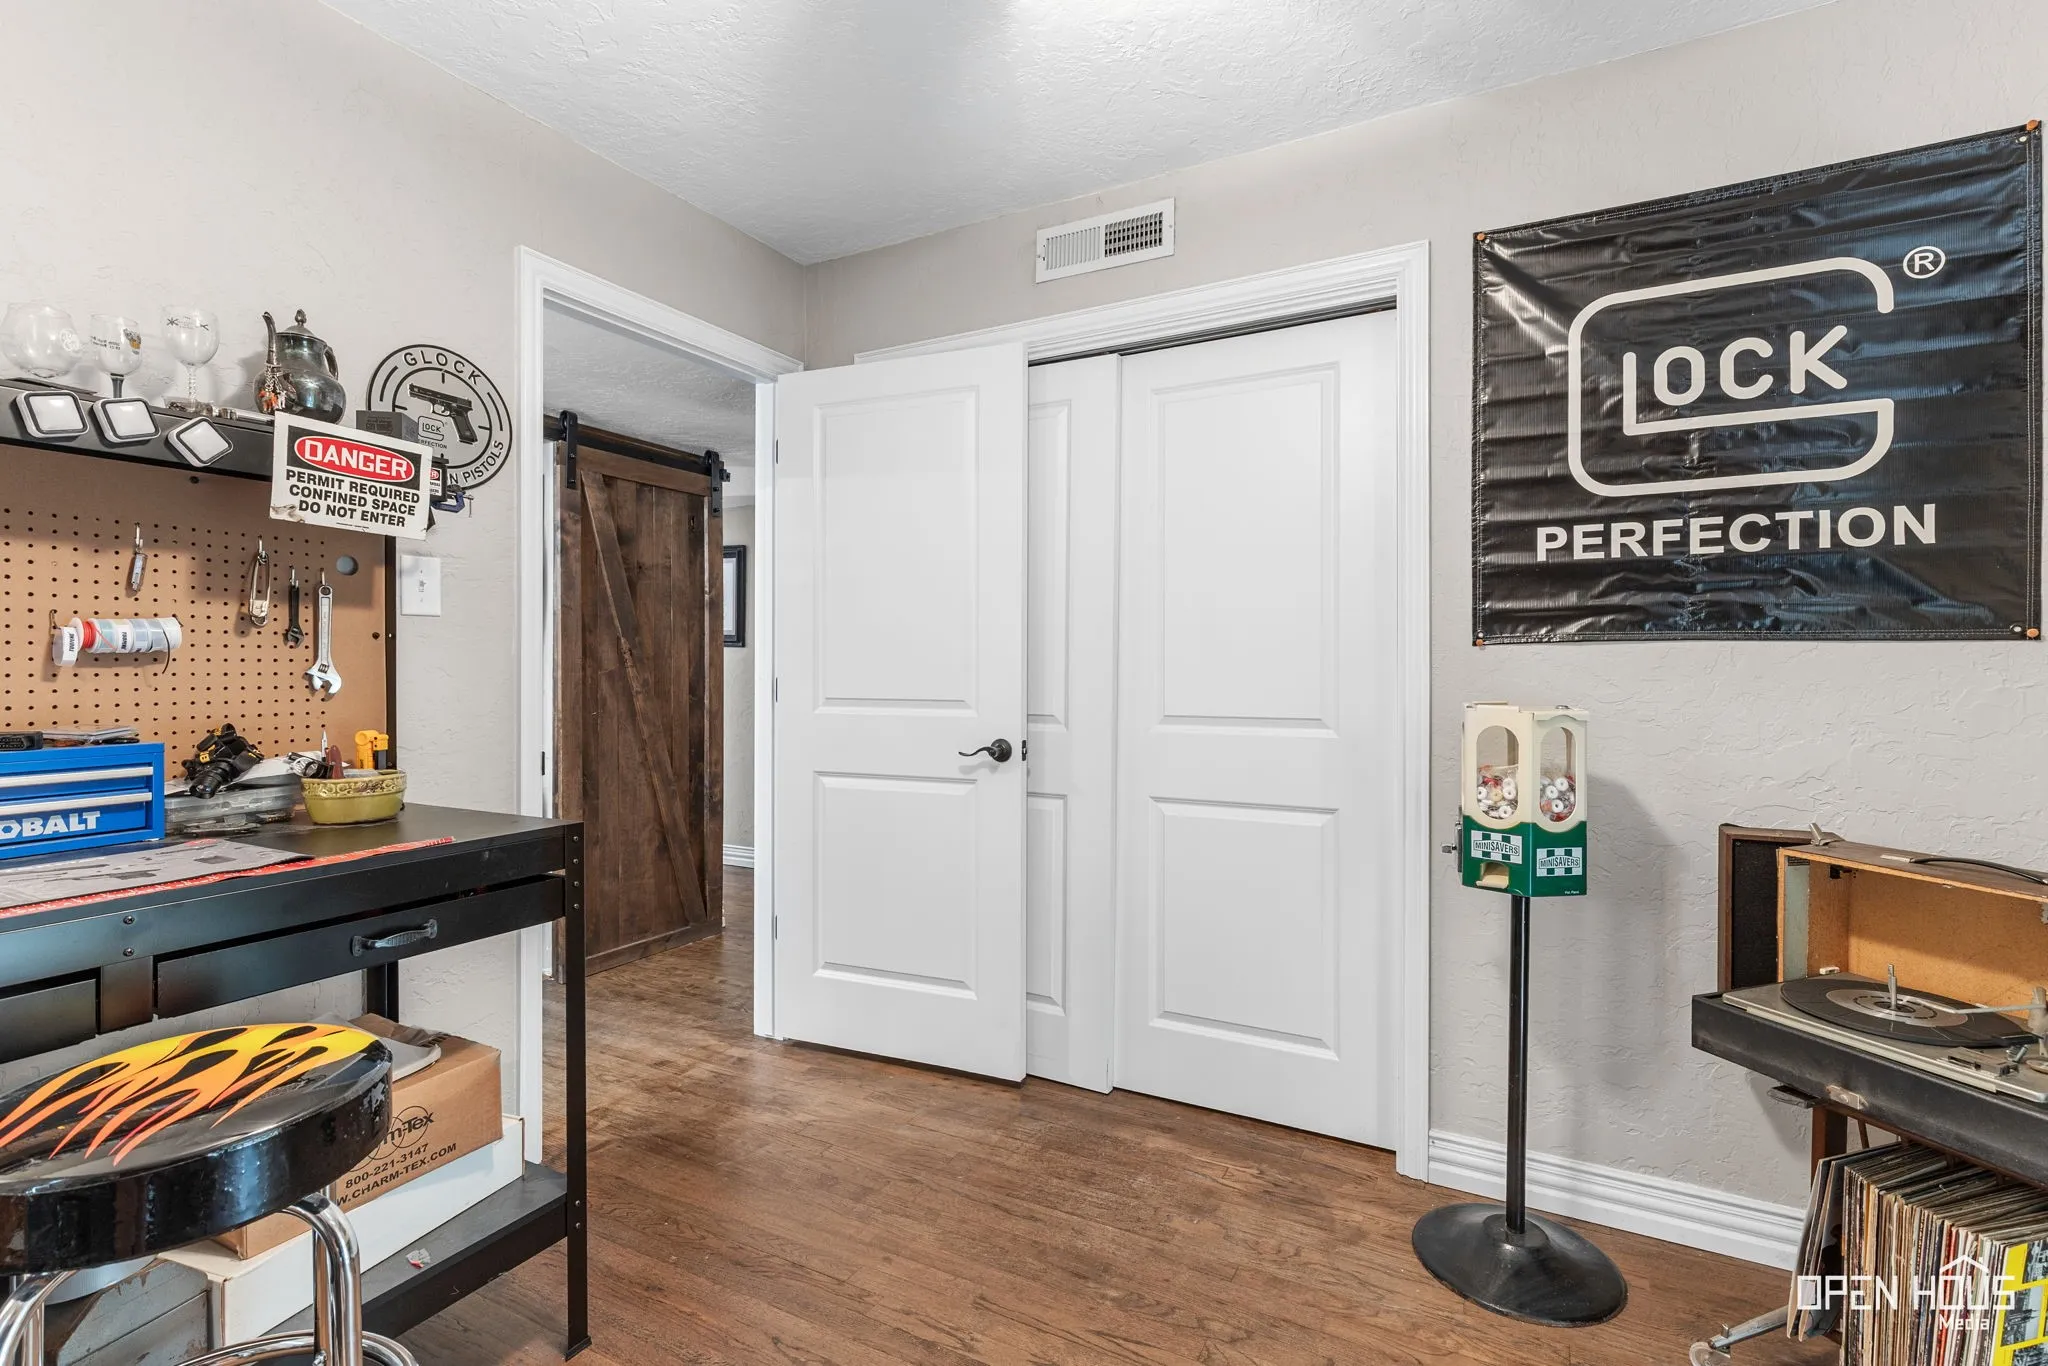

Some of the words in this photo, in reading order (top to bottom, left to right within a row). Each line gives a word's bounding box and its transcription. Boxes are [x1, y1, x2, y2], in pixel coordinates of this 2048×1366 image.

[403, 350, 481, 386] GLOCK
[304, 439, 408, 479] DANGER
[462, 440, 504, 483] PISTOLS
[285, 468, 345, 490] PERMIT
[349, 481, 420, 503] REQUIRED
[289, 484, 367, 508] CONFINED
[371, 498, 416, 516] SPACE
[299, 500, 321, 514] DO
[325, 503, 357, 519] NOT
[360, 510, 406, 528] ENTER
[1535, 503, 1936, 562] PERFECTION
[0, 811, 101, 839] OBALT
[1475, 841, 1519, 855] MINISAVERS
[1540, 856, 1579, 867] MINISAVERS
[383, 1112, 435, 1145] m-Tex
[337, 1143, 457, 1206] W.CHARM-TEX.COM
[345, 1143, 429, 1189] 800-221-3147
